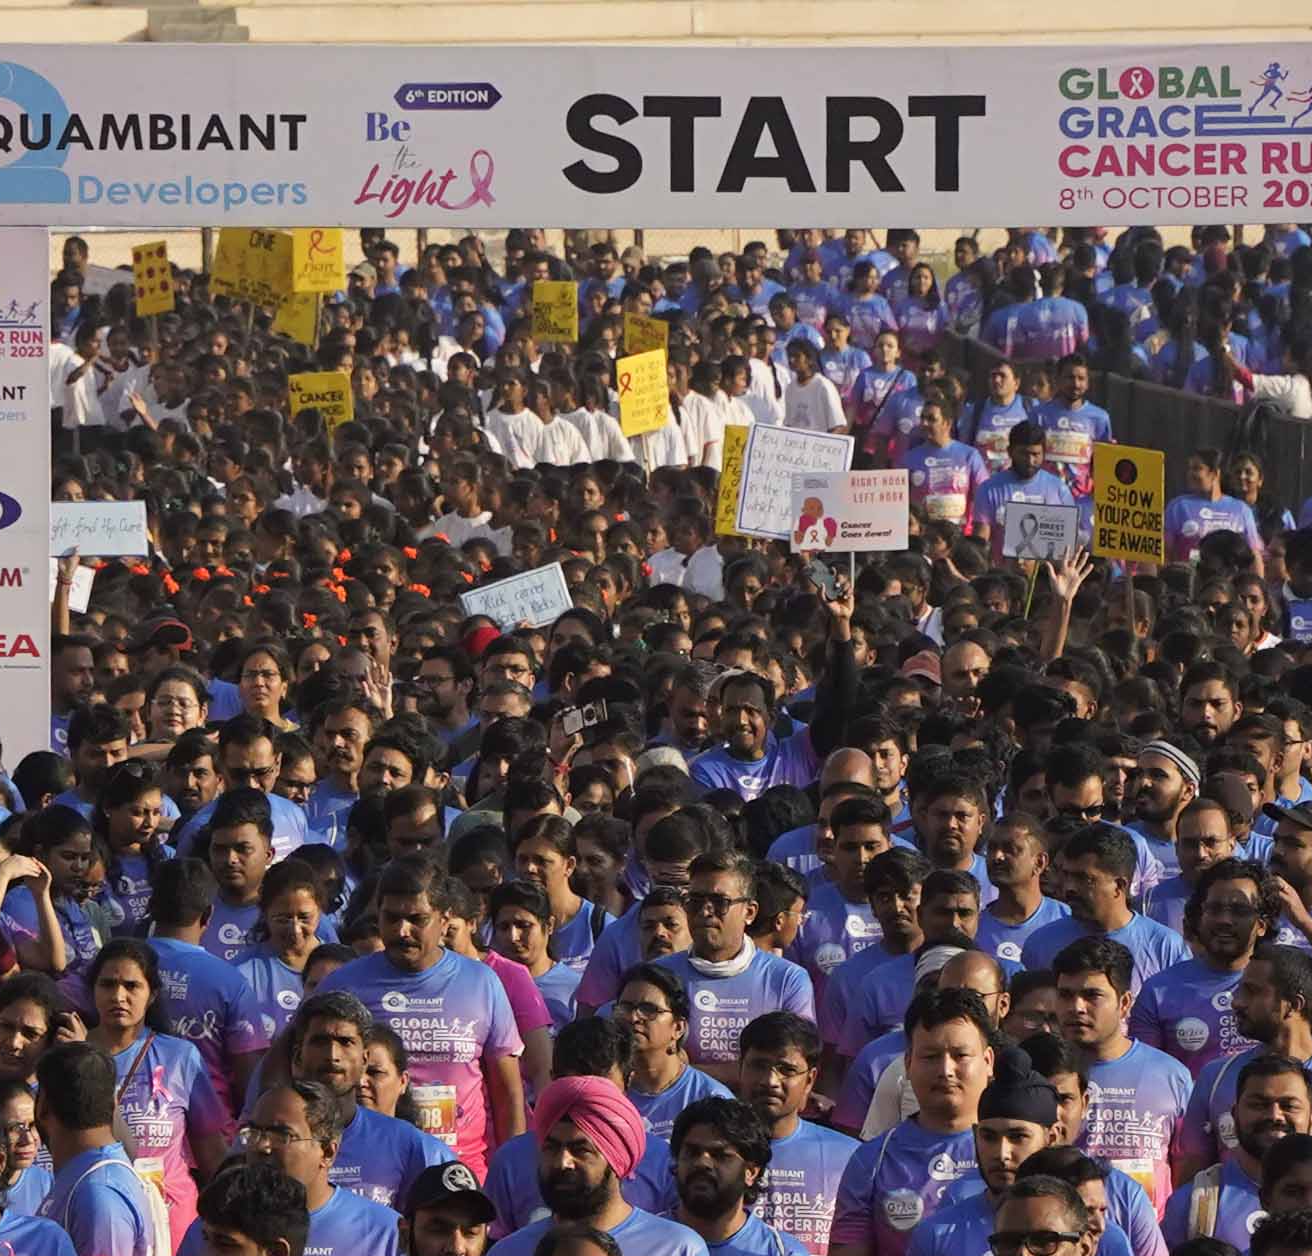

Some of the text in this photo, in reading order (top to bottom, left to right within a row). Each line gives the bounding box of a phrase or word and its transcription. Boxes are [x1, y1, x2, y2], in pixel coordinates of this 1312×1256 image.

[1059, 65, 1242, 100] GLOBAL
[405, 89, 489, 103] 6th EDITION
[366, 111, 411, 142] Be
[1059, 104, 1285, 138] GRACE
[561, 93, 986, 195] START
[1059, 143, 1248, 177] CANCER
[78, 175, 308, 212] Developers
[354, 163, 460, 218] Light
[1059, 187, 1094, 210] 8th
[1103, 185, 1248, 209] OCTOBER
[10, 331, 43, 344] RUN
[10, 347, 44, 357] 2023
[1107, 485, 1154, 508] SHOW
[1096, 503, 1163, 532] YOUR CARE
[1099, 527, 1162, 556] BE AWARE
[390, 1017, 448, 1030] GLOBAL
[399, 1029, 442, 1040] RACE
[454, 1040, 476, 1053] RUN
[700, 1040, 738, 1051] CANC
[1088, 1109, 1138, 1121] GLOBAL
[148, 1124, 173, 1137] RUN
[1087, 1134, 1140, 1147] CANCER
